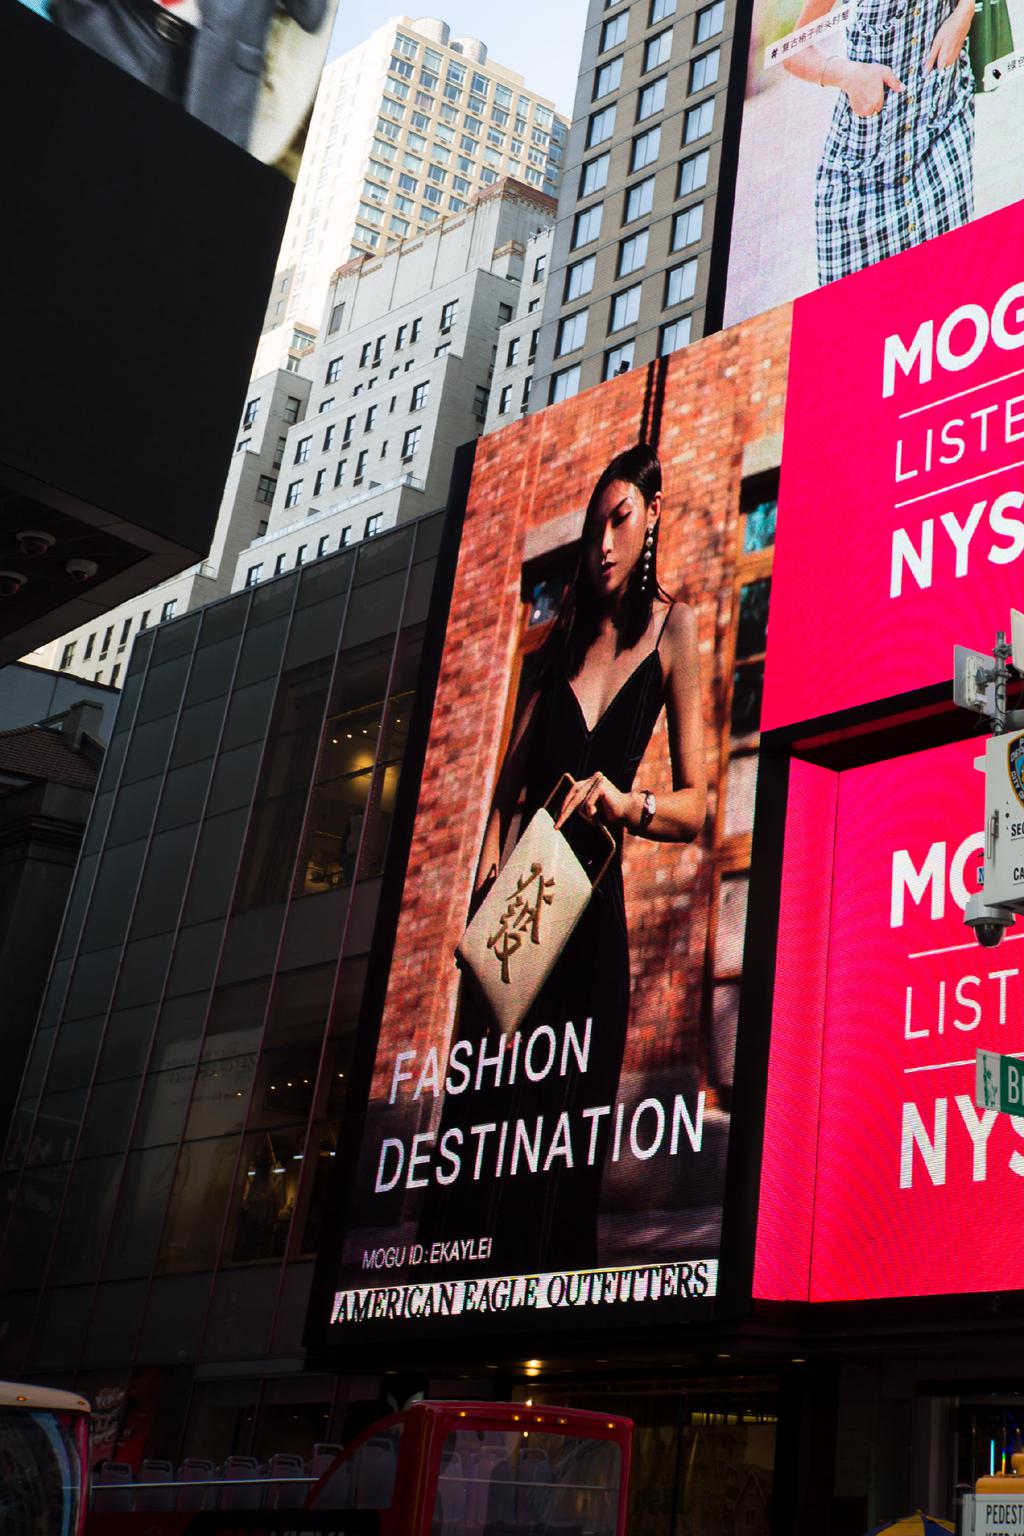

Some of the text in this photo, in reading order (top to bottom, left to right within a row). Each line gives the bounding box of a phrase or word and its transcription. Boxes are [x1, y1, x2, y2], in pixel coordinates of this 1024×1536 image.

[388, 1017, 594, 1105] FASHION
[374, 1092, 707, 1194] DESTINATION
[335, 1261, 710, 1324] AMERICAN EAGLE OUTFITTERS
[362, 1247, 405, 1270] MOGU
